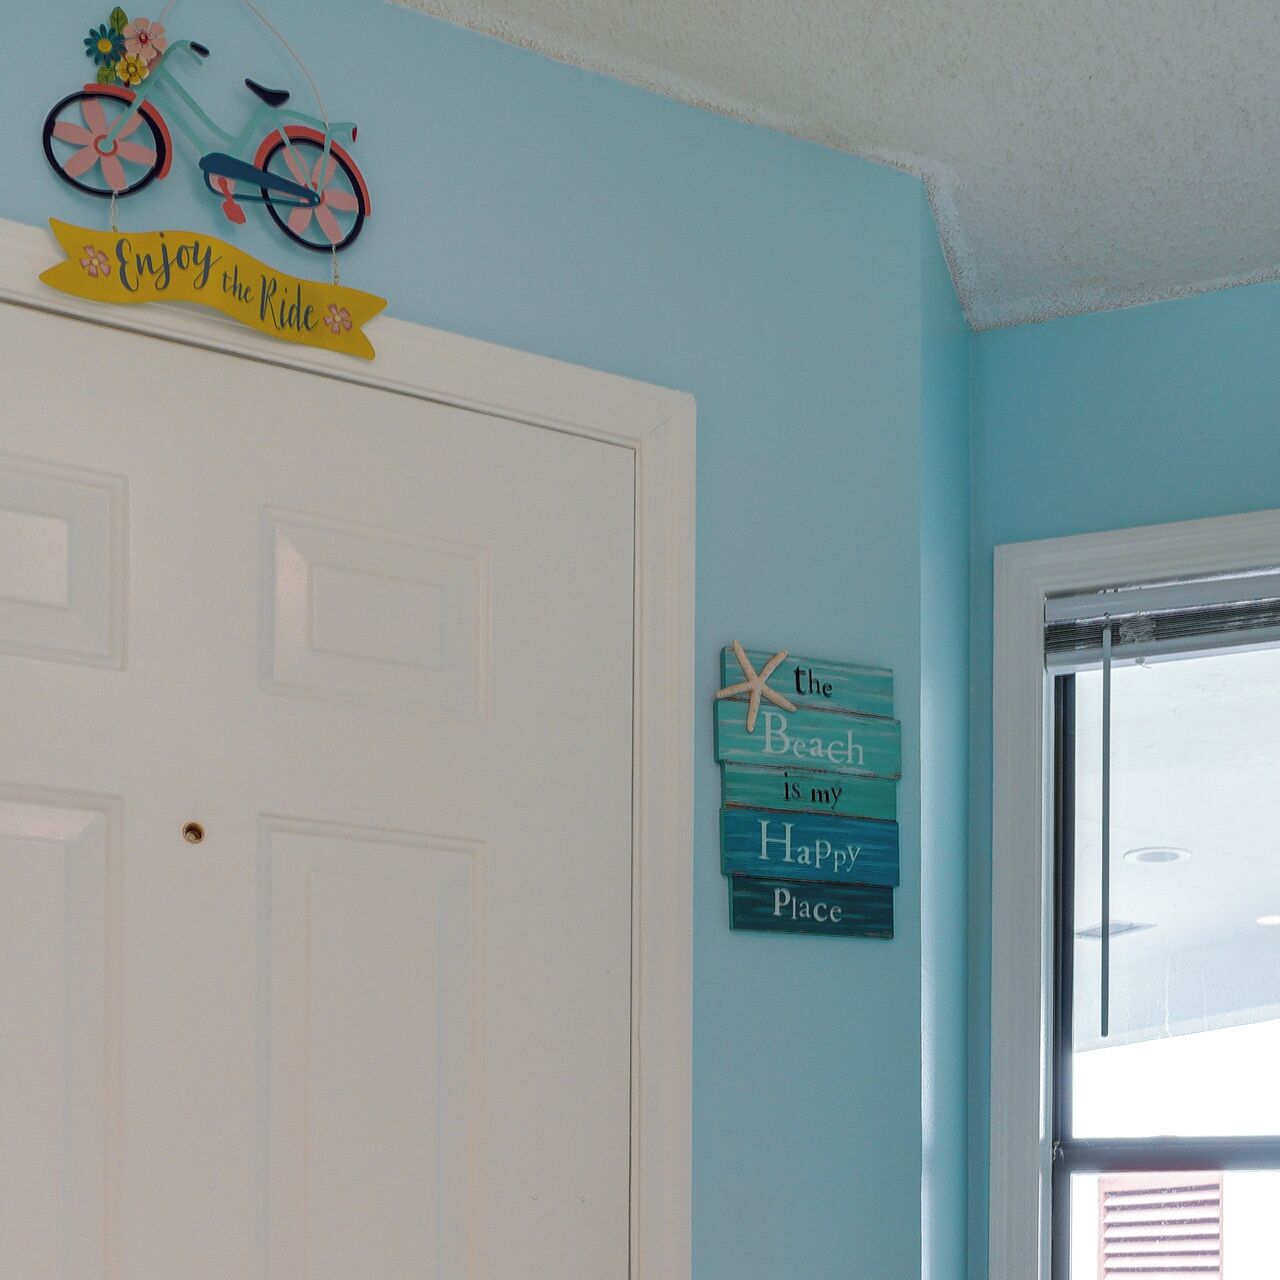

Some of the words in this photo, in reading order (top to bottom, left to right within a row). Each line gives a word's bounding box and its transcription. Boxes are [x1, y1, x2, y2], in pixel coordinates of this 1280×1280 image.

[115, 232, 223, 291] Enjoy
[222, 264, 256, 304] the
[258, 274, 320, 331] Ride
[793, 665, 833, 698] the
[762, 711, 864, 766] Beach
[783, 772, 801, 801] is
[811, 786, 842, 810] my
[758, 819, 862, 871] Happy
[773, 886, 842, 924] Place
